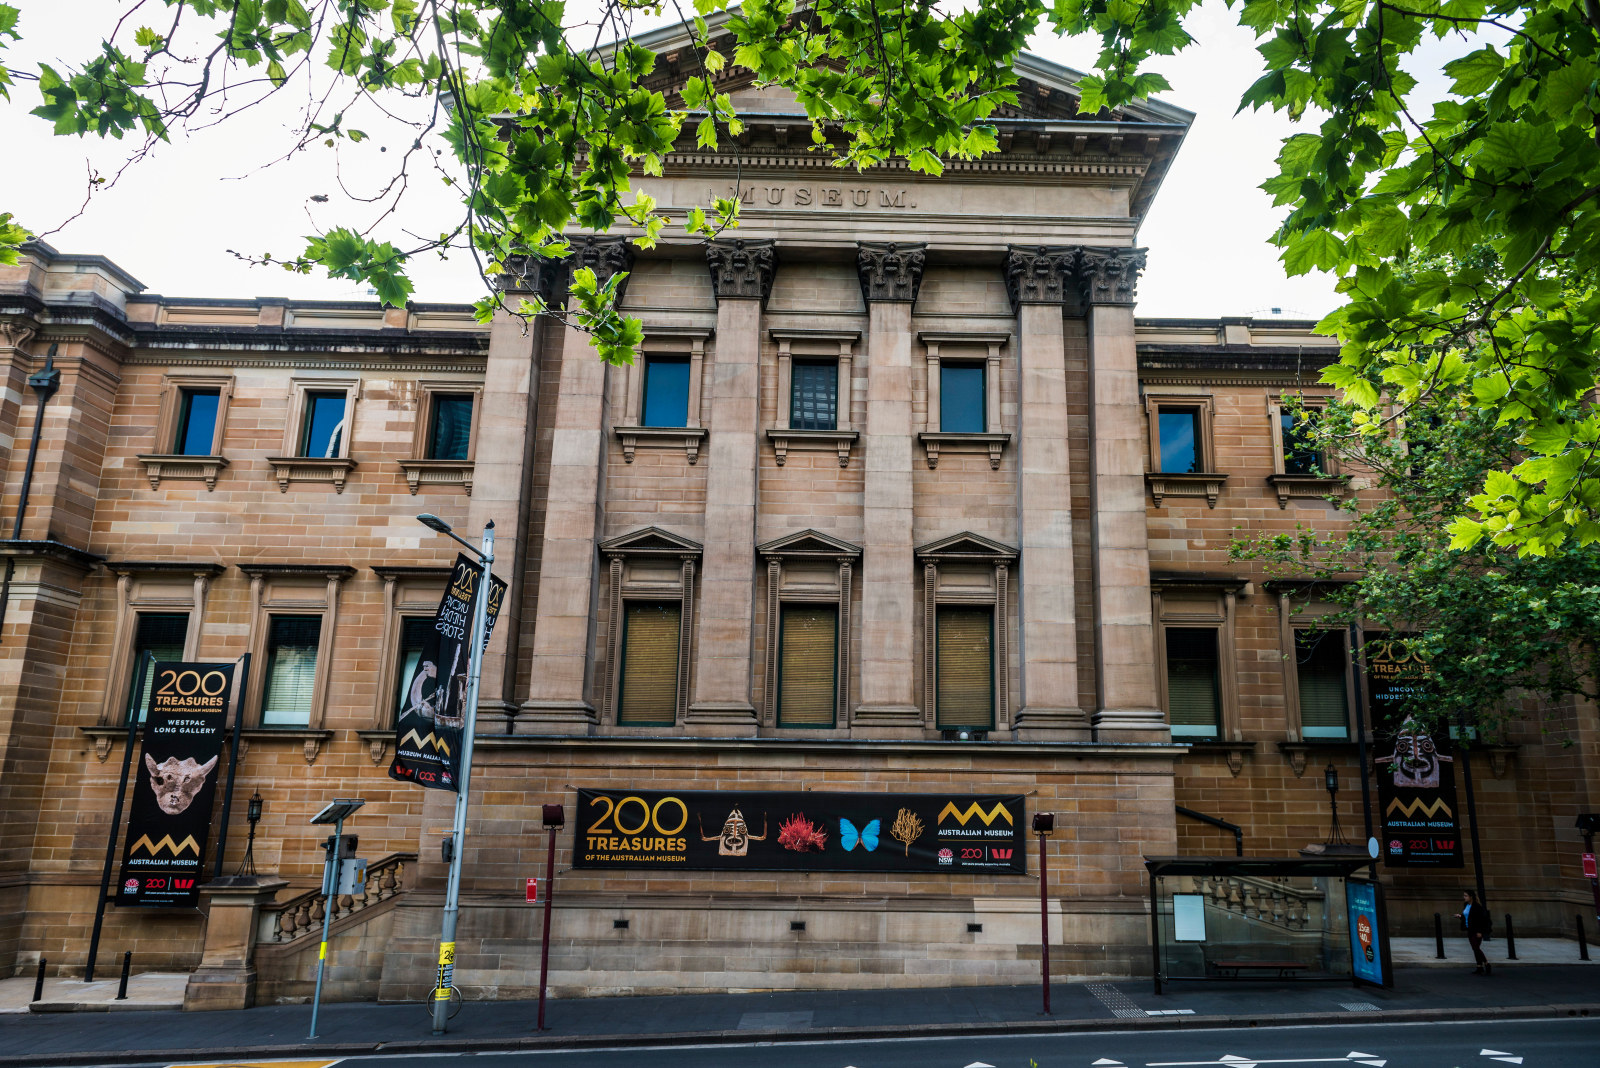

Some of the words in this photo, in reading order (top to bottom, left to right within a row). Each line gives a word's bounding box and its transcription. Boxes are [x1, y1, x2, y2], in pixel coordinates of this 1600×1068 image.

[156, 670, 226, 696] 200
[156, 696, 224, 706] TREASURES
[587, 796, 688, 835] 200
[586, 837, 687, 851] TREASURES
[1409, 840, 1428, 849] 200
[961, 848, 982, 858] 200
[145, 879, 166, 888] 200
